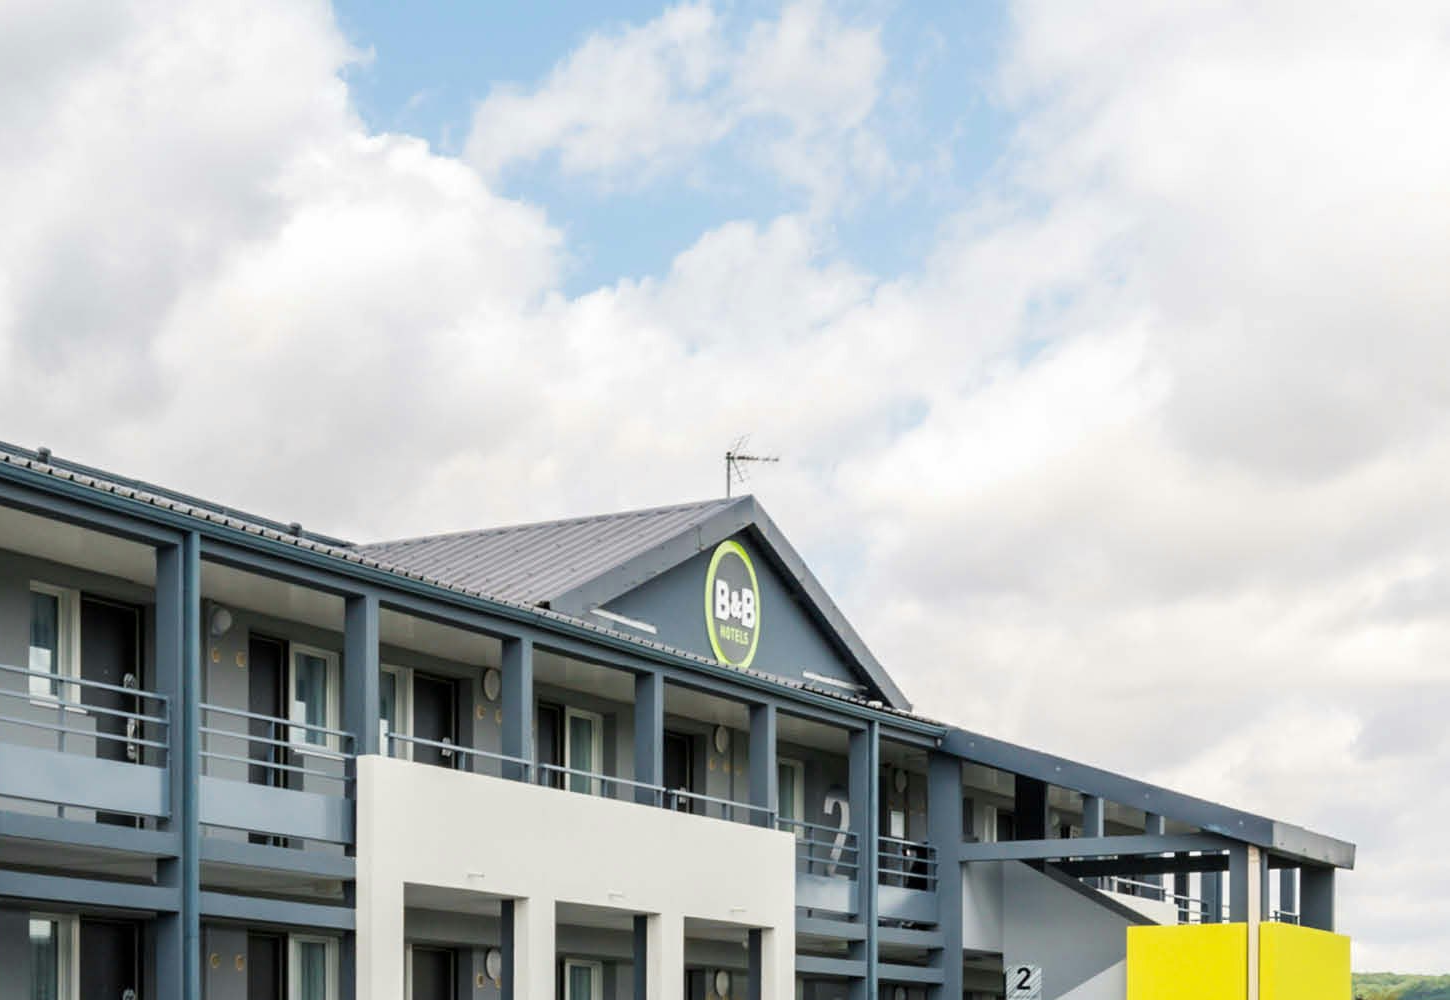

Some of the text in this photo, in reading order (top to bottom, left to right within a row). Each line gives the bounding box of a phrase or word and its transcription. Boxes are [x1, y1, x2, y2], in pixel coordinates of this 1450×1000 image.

[715, 579, 755, 629] B&B
[719, 624, 749, 645] HOTELS
[1017, 967, 1031, 990] 2
